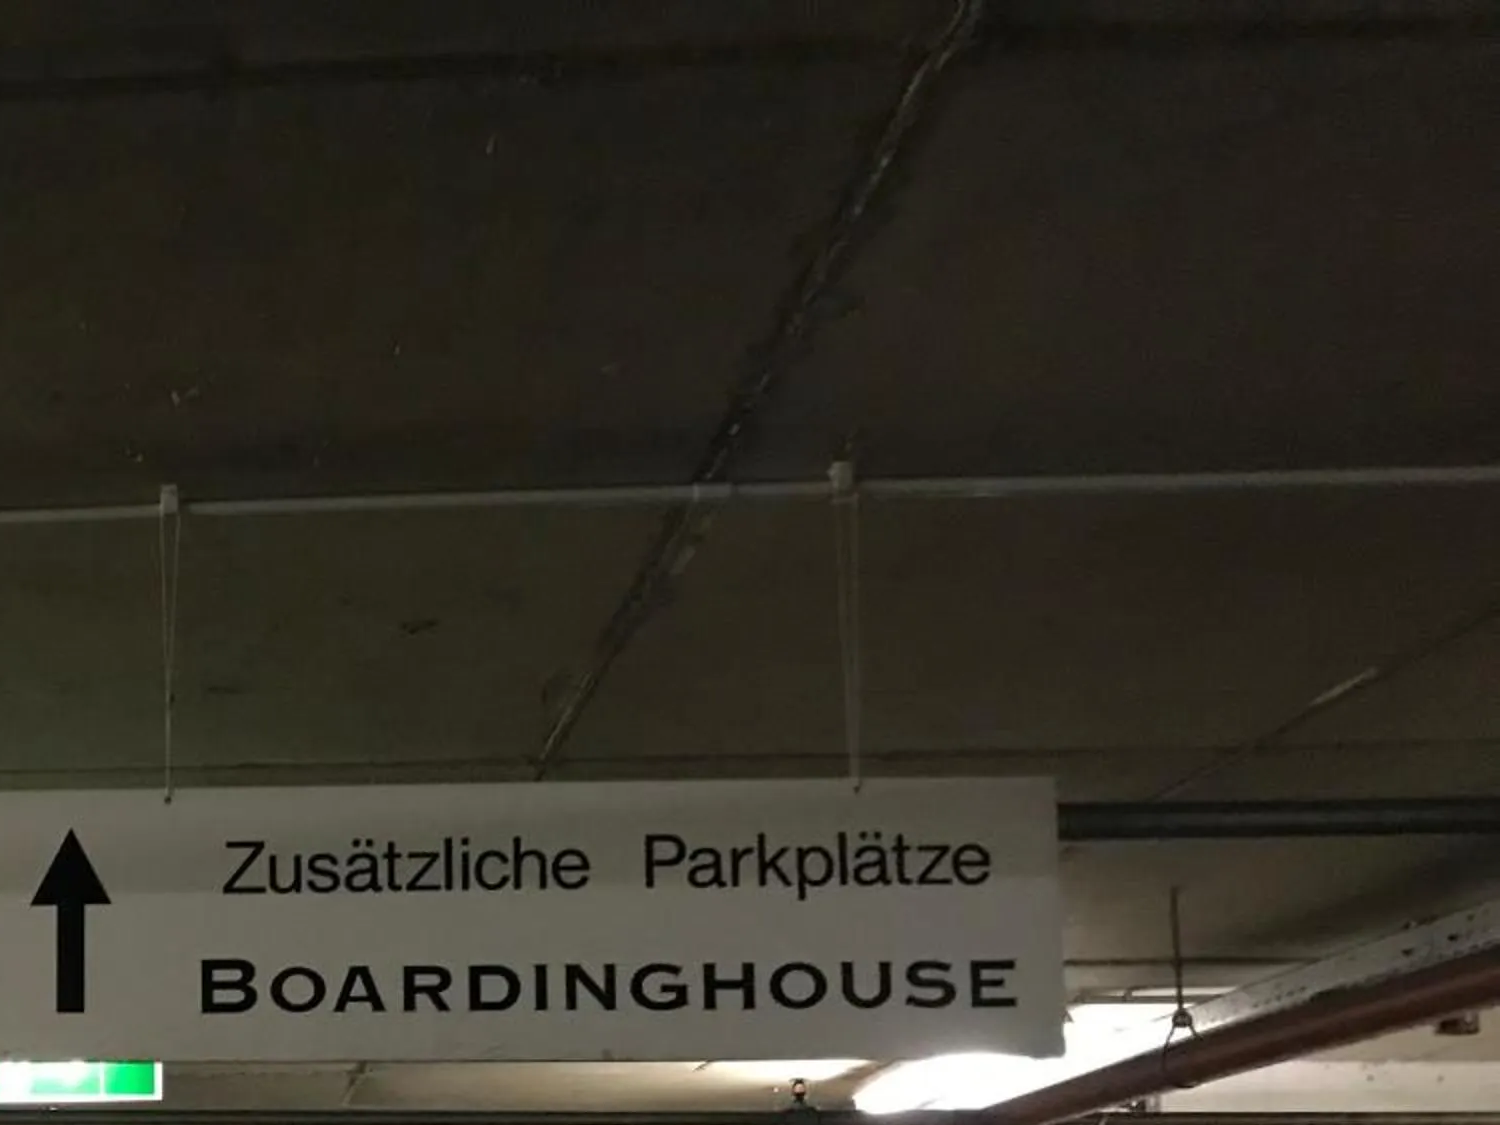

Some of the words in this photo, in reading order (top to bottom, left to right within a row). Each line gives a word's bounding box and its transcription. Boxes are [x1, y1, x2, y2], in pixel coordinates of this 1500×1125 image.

[222, 836, 591, 895] Zusätzliche
[644, 831, 992, 901] Parkplätze
[200, 957, 1018, 1014] BOARDINGHOUSE
